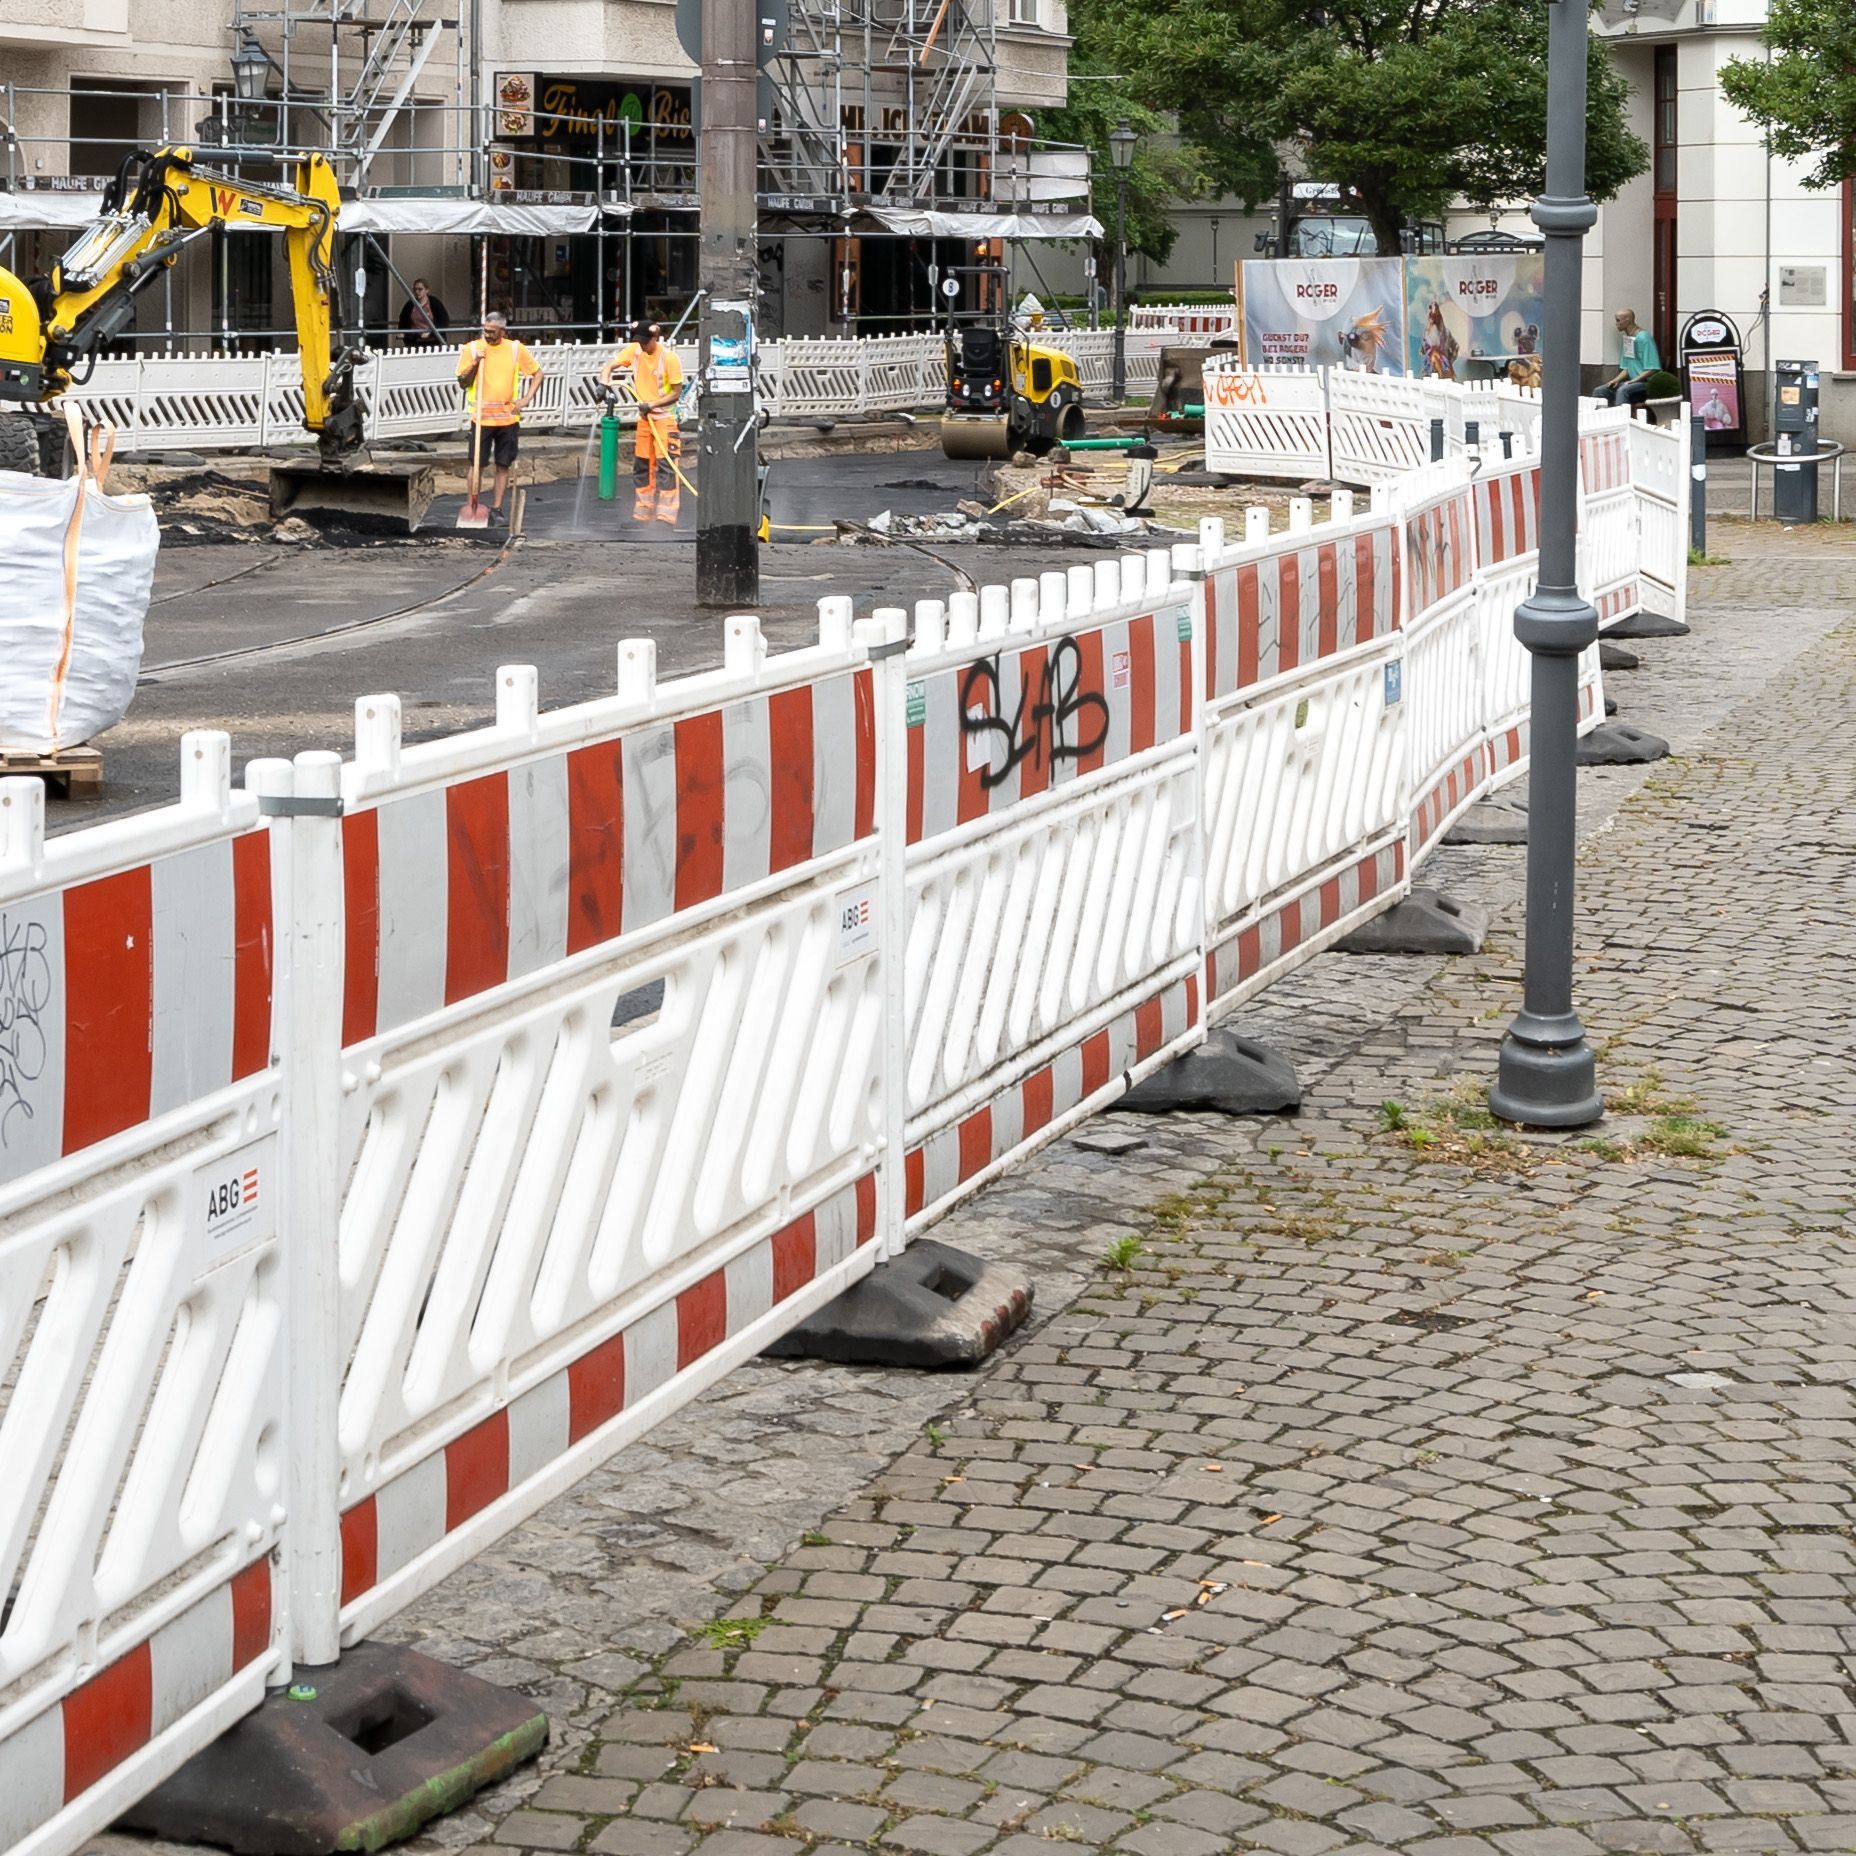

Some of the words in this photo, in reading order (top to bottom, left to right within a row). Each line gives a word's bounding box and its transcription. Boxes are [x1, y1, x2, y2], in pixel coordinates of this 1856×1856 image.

[1296, 283, 1338, 298] ROGER
[1459, 279, 1498, 295] ROGER
[841, 904, 859, 934] ABG
[207, 1178, 239, 1222] ABG
